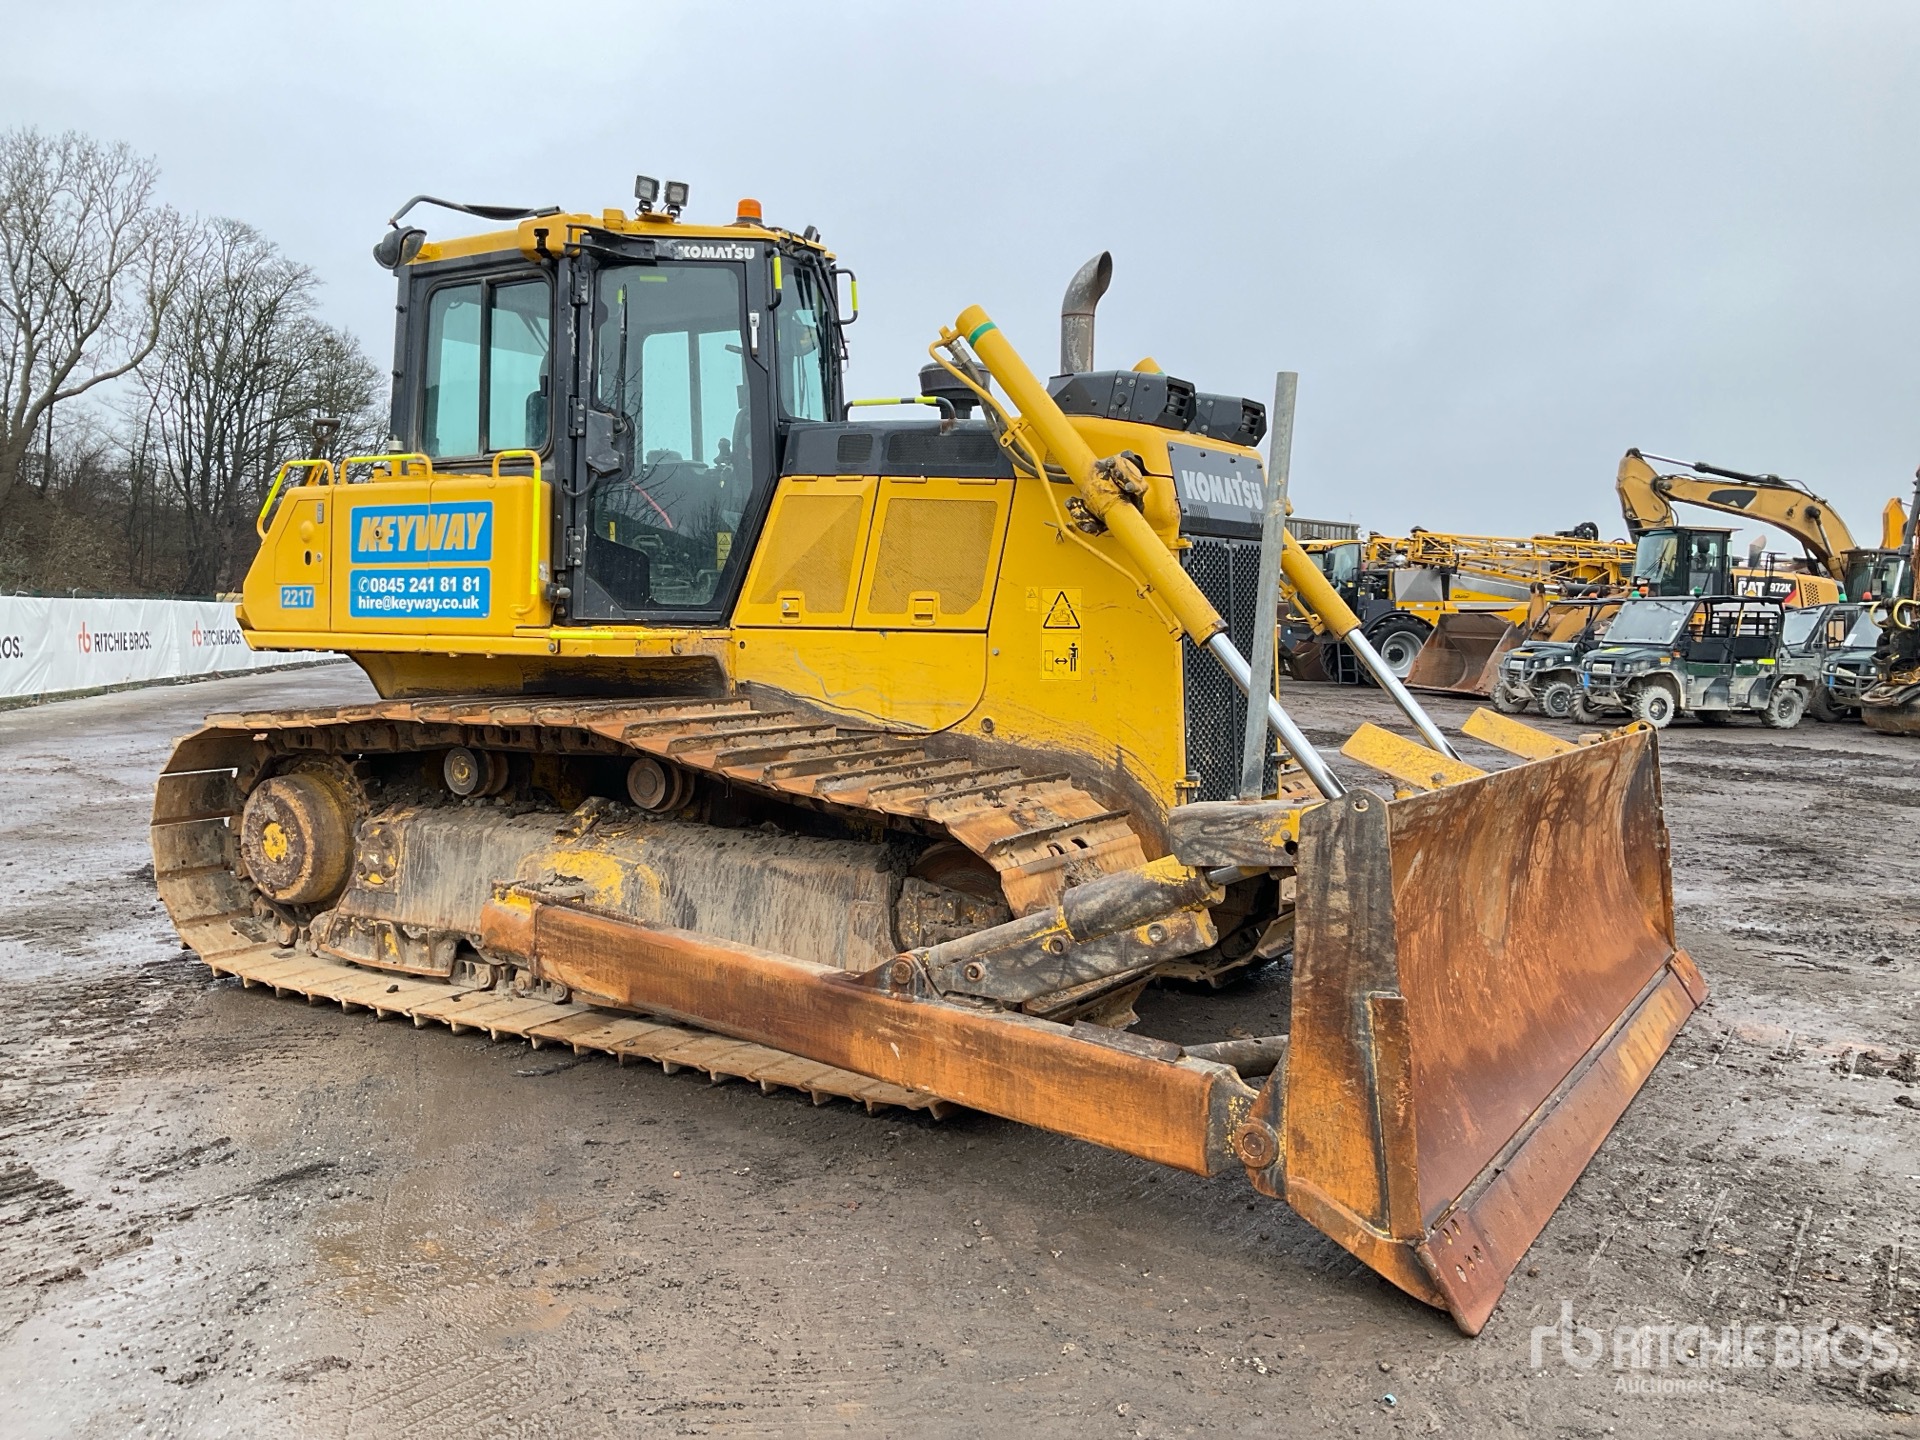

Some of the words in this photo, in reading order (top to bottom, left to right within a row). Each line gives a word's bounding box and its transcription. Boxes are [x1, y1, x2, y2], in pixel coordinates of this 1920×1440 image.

[678, 244, 755, 260] KOMATSU
[1181, 469, 1264, 511] KOMATSU
[358, 512, 487, 552] KEYWAY
[369, 577, 405, 593] 0845
[409, 577, 434, 593] 241
[440, 577, 457, 592] 81
[462, 576, 480, 592] 81
[1737, 580, 1766, 597] CAT
[1770, 582, 1792, 593] 972K
[283, 589, 313, 606] 2217
[358, 595, 480, 612] hire@keyway.co.uk
[0, 636, 23, 659] OS.
[94, 631, 128, 652] RITCHIE
[129, 631, 152, 651] BROS.
